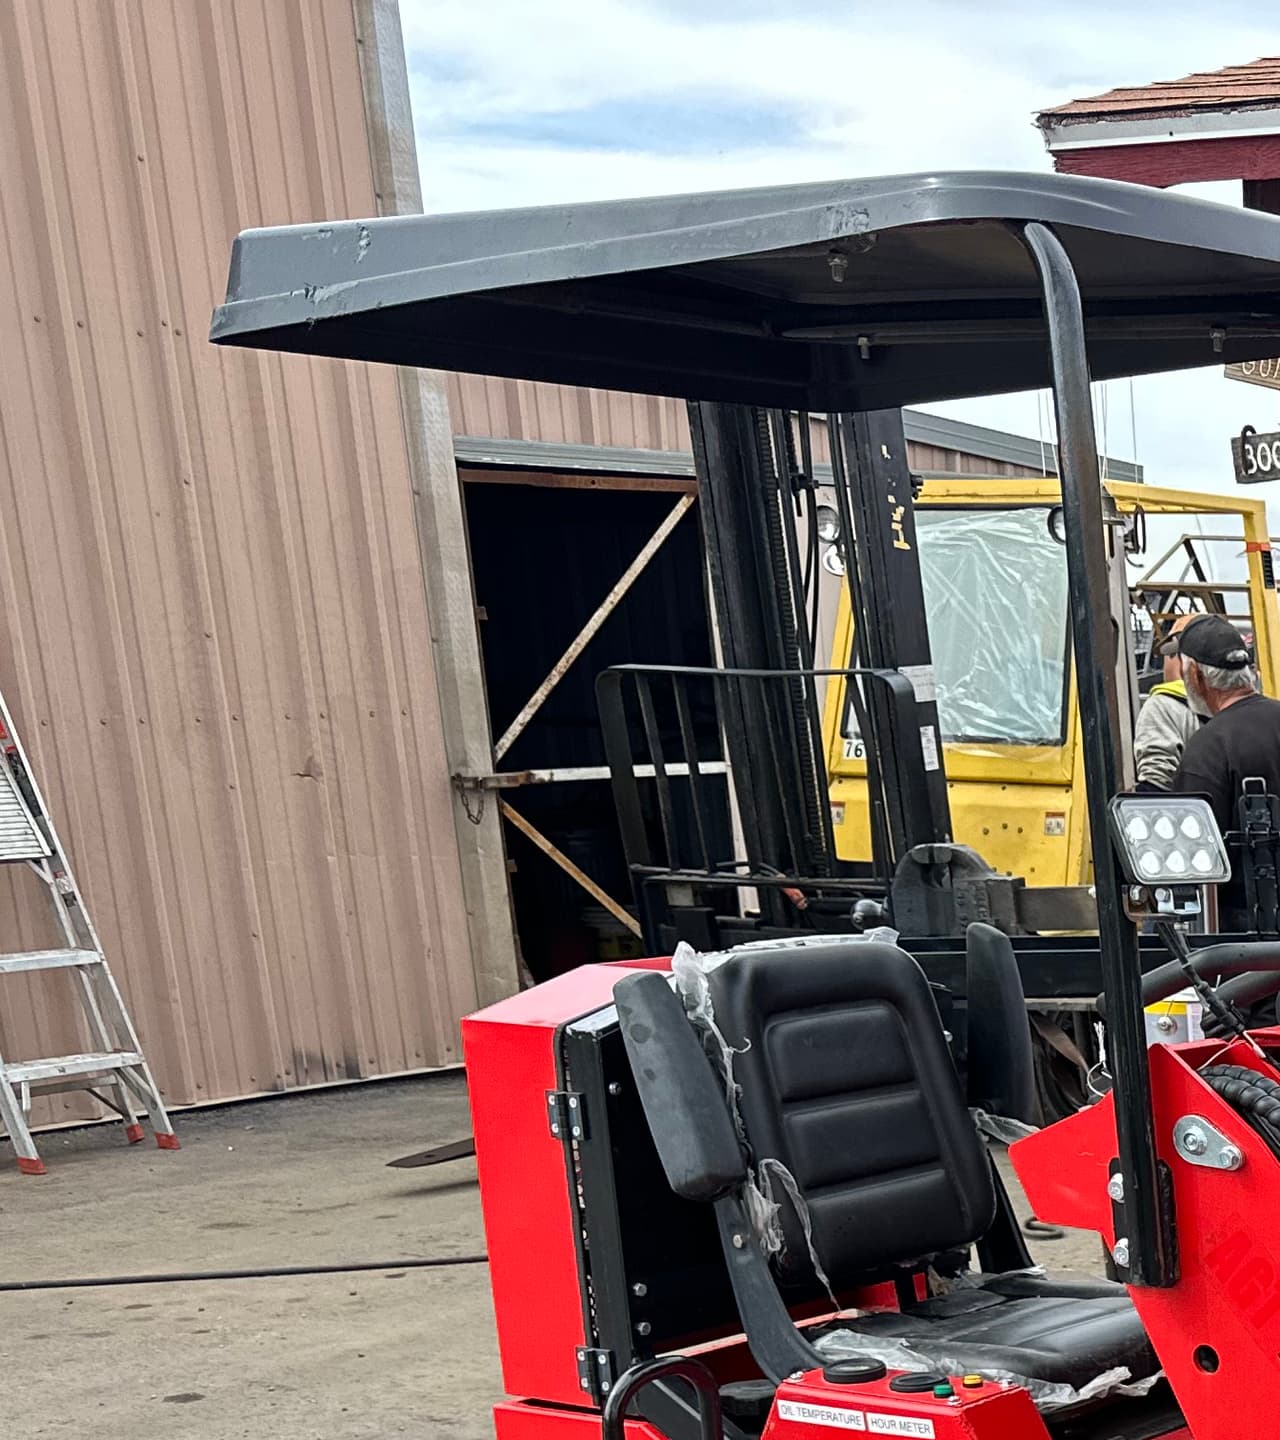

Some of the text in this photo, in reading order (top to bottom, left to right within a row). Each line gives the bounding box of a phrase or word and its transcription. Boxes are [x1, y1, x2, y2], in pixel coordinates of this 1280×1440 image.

[780, 1404, 862, 1427] OIL TEMPERATURE
[871, 1417, 931, 1434] HOUR METER
